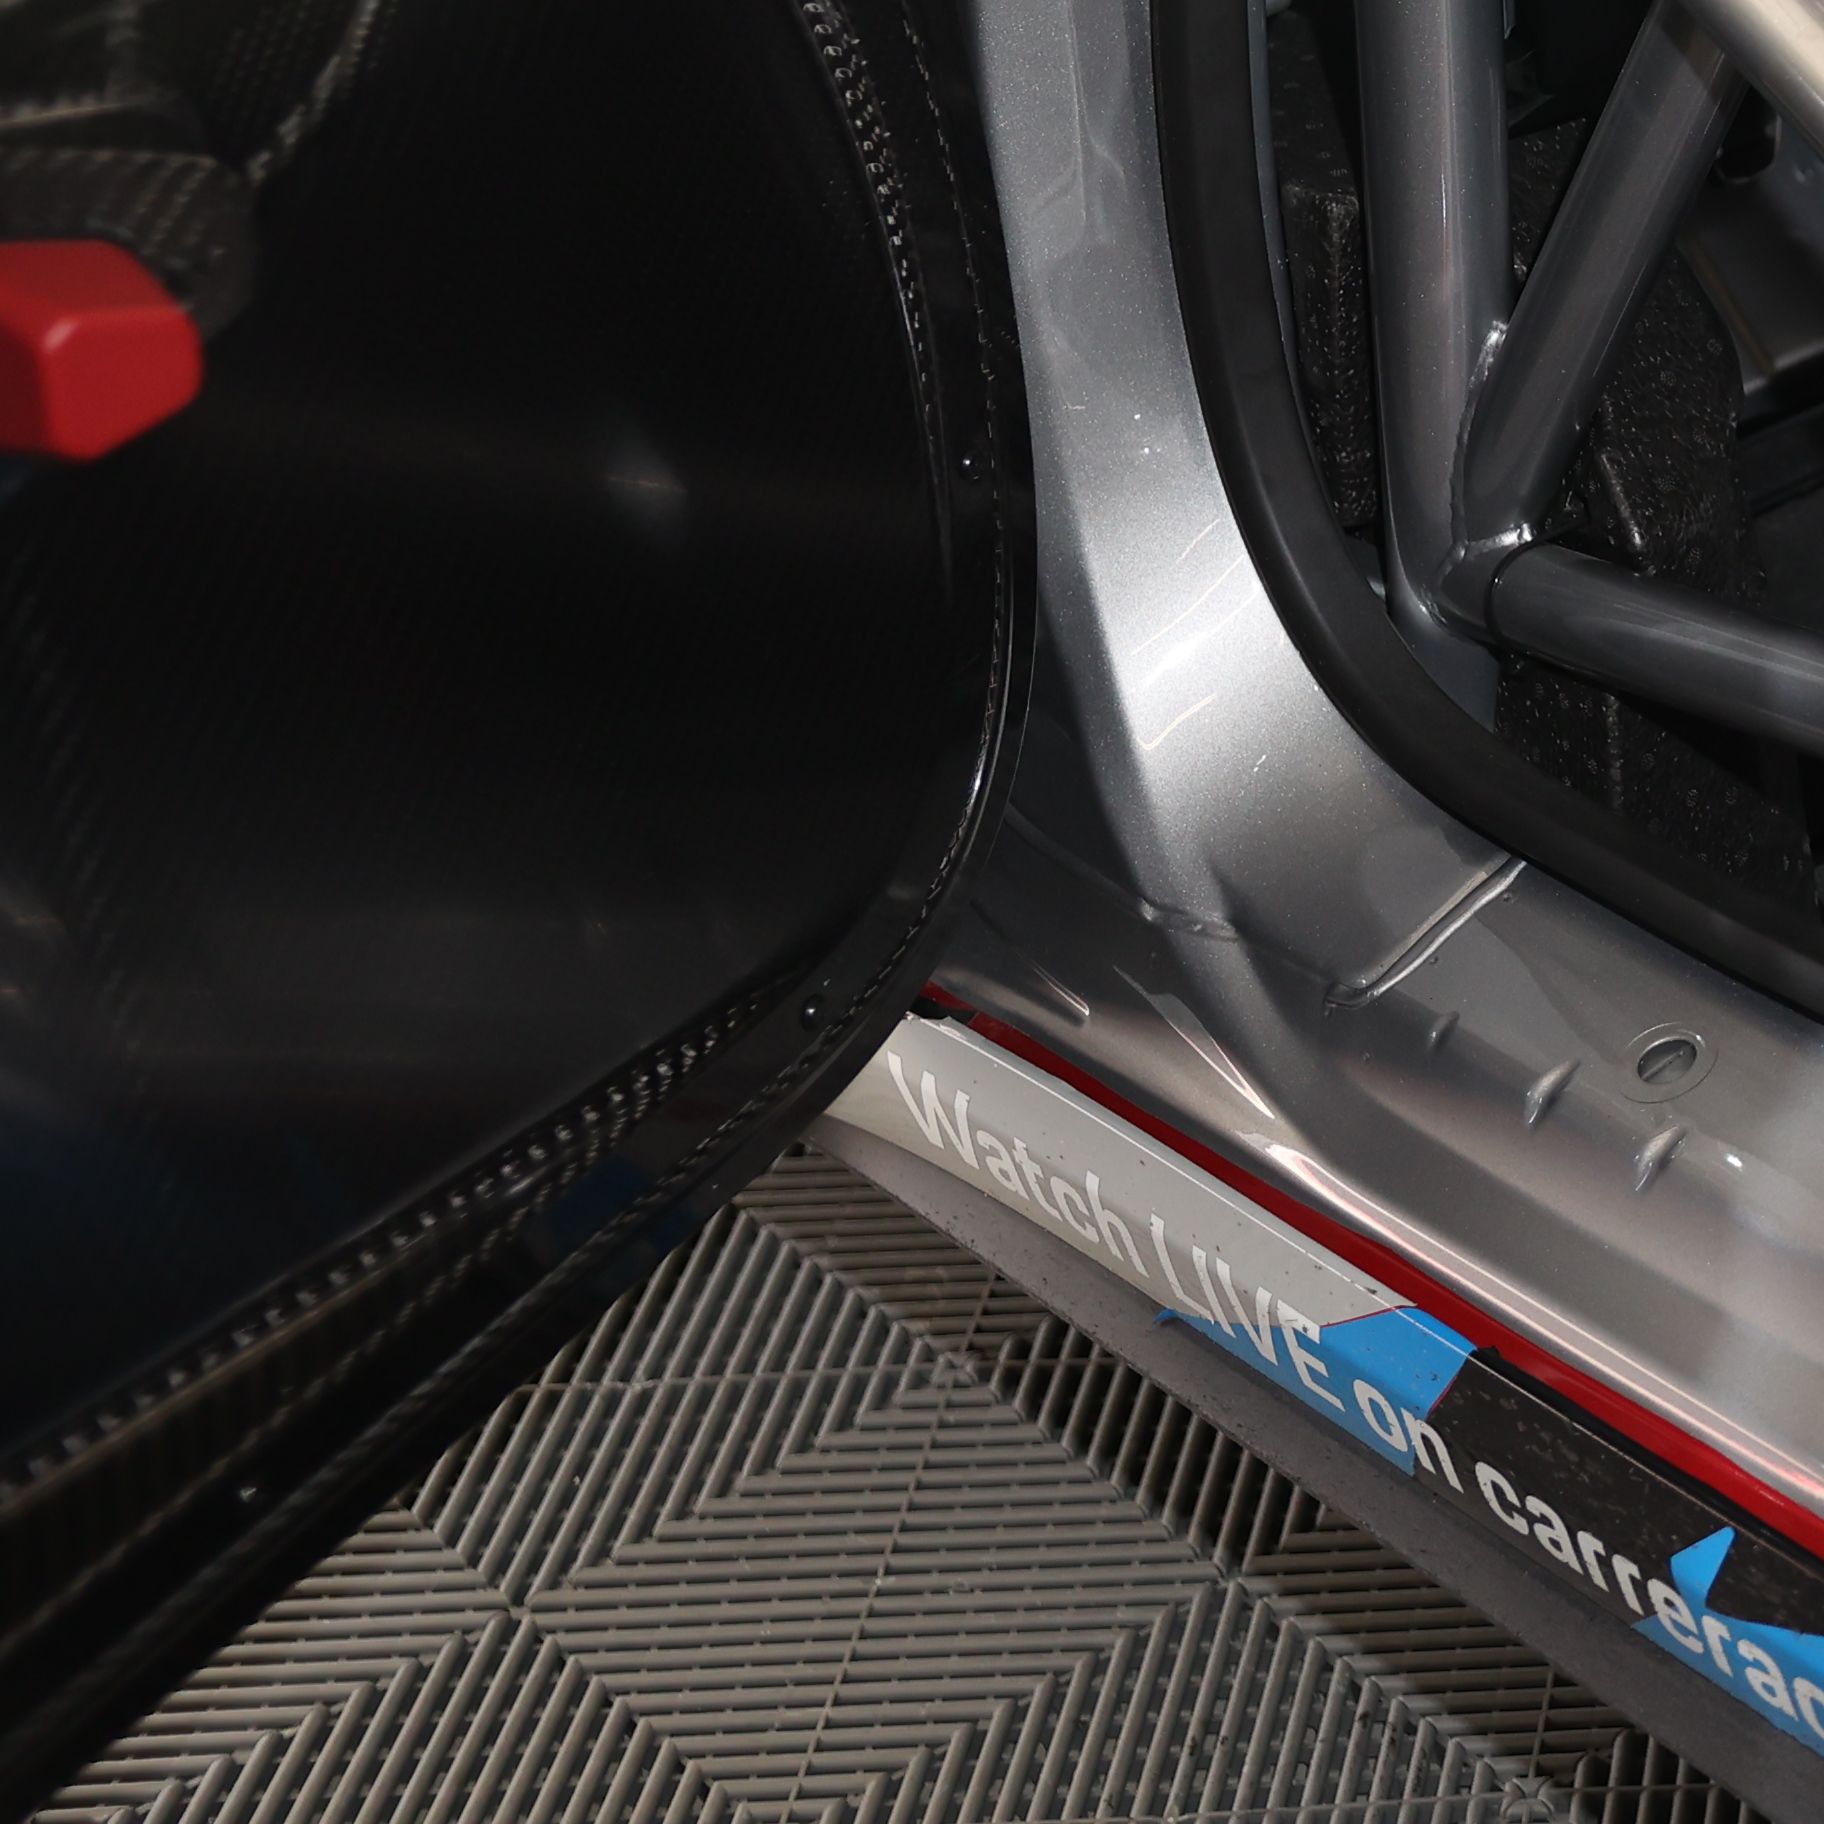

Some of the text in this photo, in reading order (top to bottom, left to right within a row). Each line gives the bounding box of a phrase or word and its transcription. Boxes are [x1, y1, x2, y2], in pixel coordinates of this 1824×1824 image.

[887, 1050, 1150, 1279] Watch
[1150, 1212, 1346, 1413] LIVE
[1352, 1378, 1465, 1495] on
